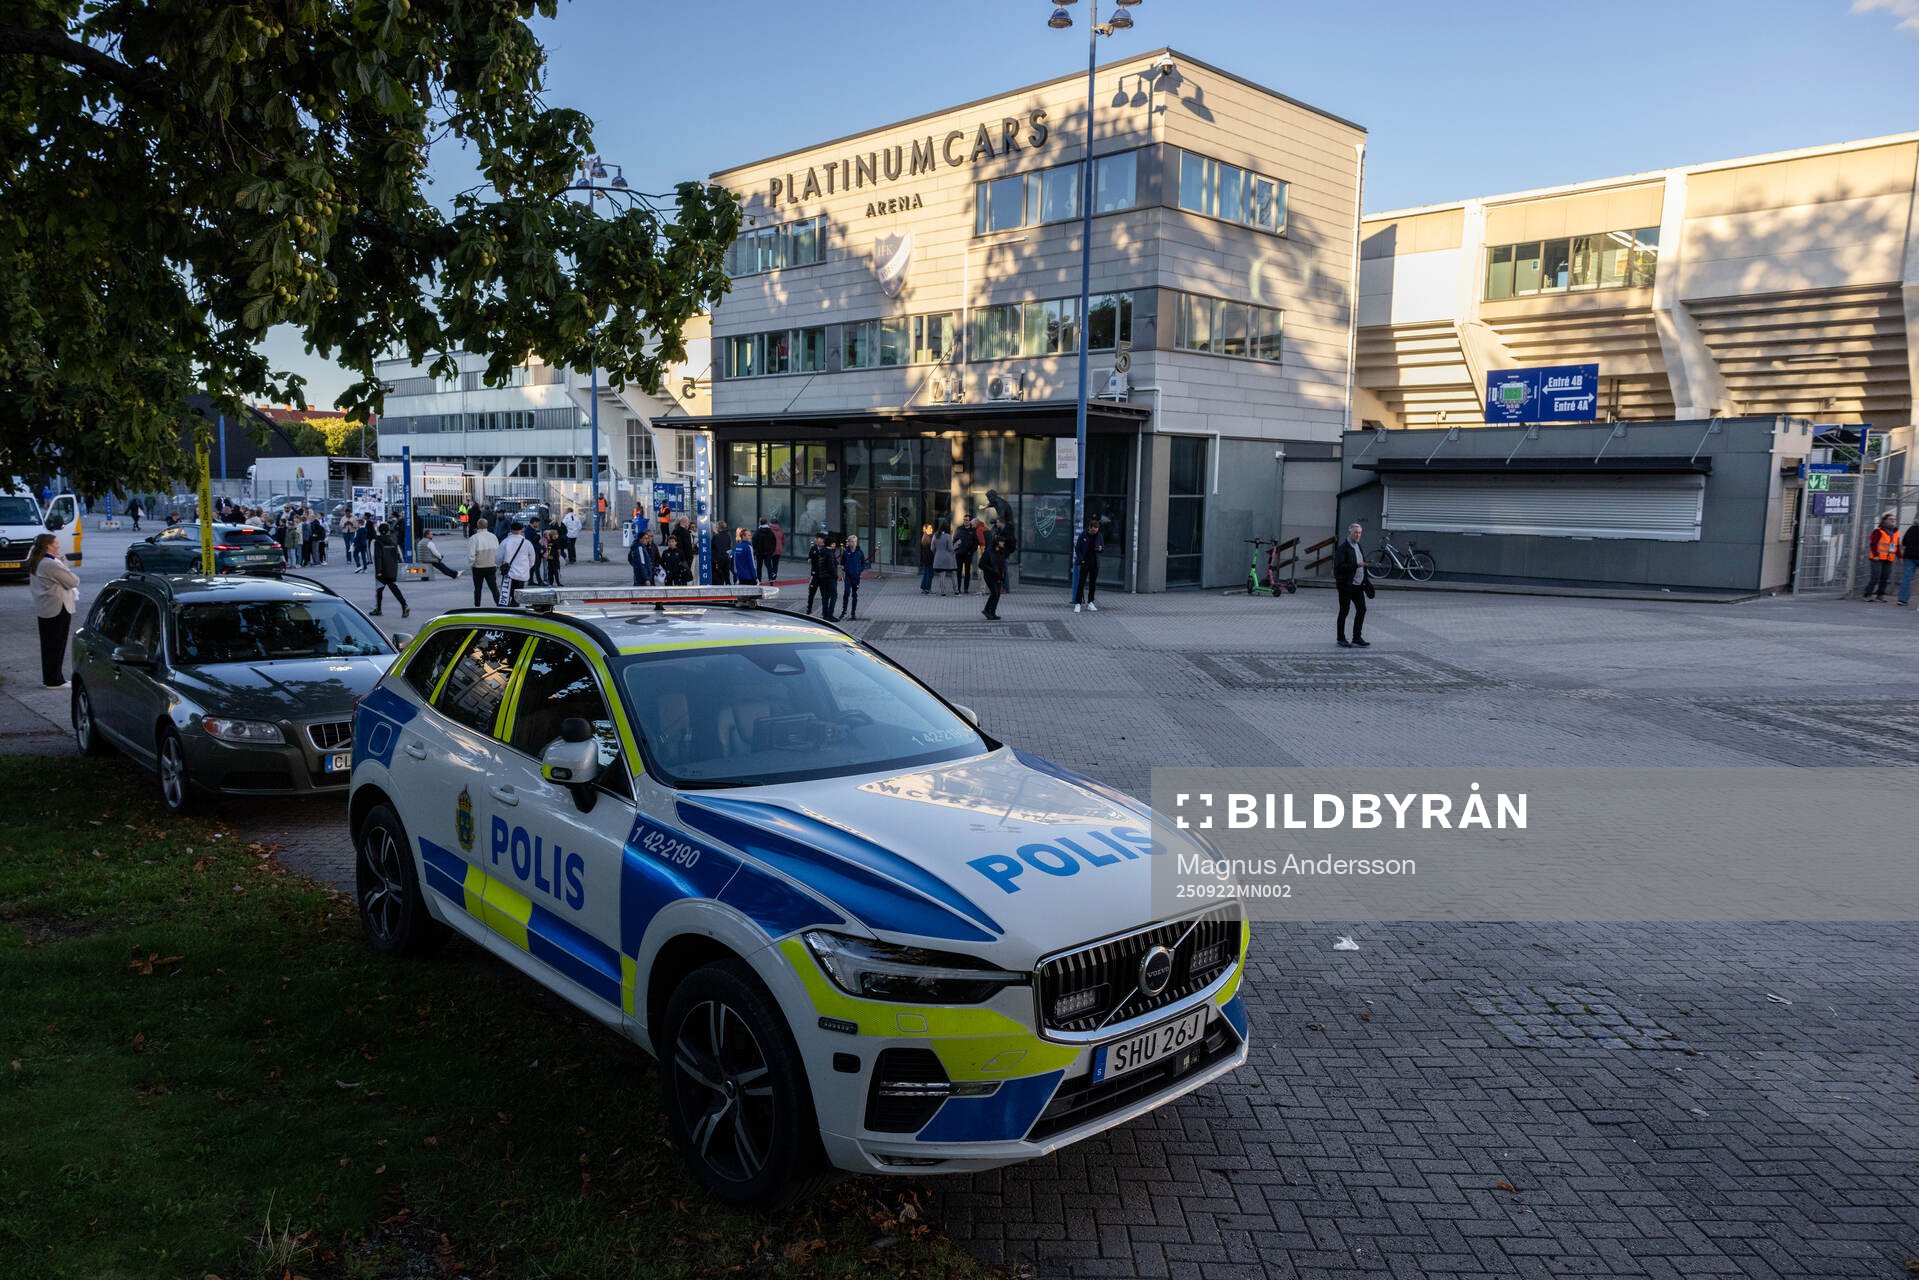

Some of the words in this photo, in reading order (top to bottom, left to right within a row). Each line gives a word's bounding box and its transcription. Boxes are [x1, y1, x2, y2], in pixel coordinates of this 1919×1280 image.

[769, 109, 1048, 208] PLATINUMCARS
[865, 193, 923, 218] ARENA
[1548, 376, 1570, 388] Entré
[1571, 375, 1583, 386] 4B
[1554, 400, 1576, 412] Entré
[1577, 400, 1589, 411] 4A
[699, 461, 707, 511] PEKING
[701, 529, 709, 579] PEKING
[491, 814, 585, 911] POLIS
[632, 825, 642, 843] 1
[643, 831, 701, 869] 42-2190
[965, 826, 1168, 895] POLIS
[1147, 967, 1170, 978] VOLVO
[1114, 1033, 1157, 1071] SHU
[1162, 1014, 1199, 1053] 26J
